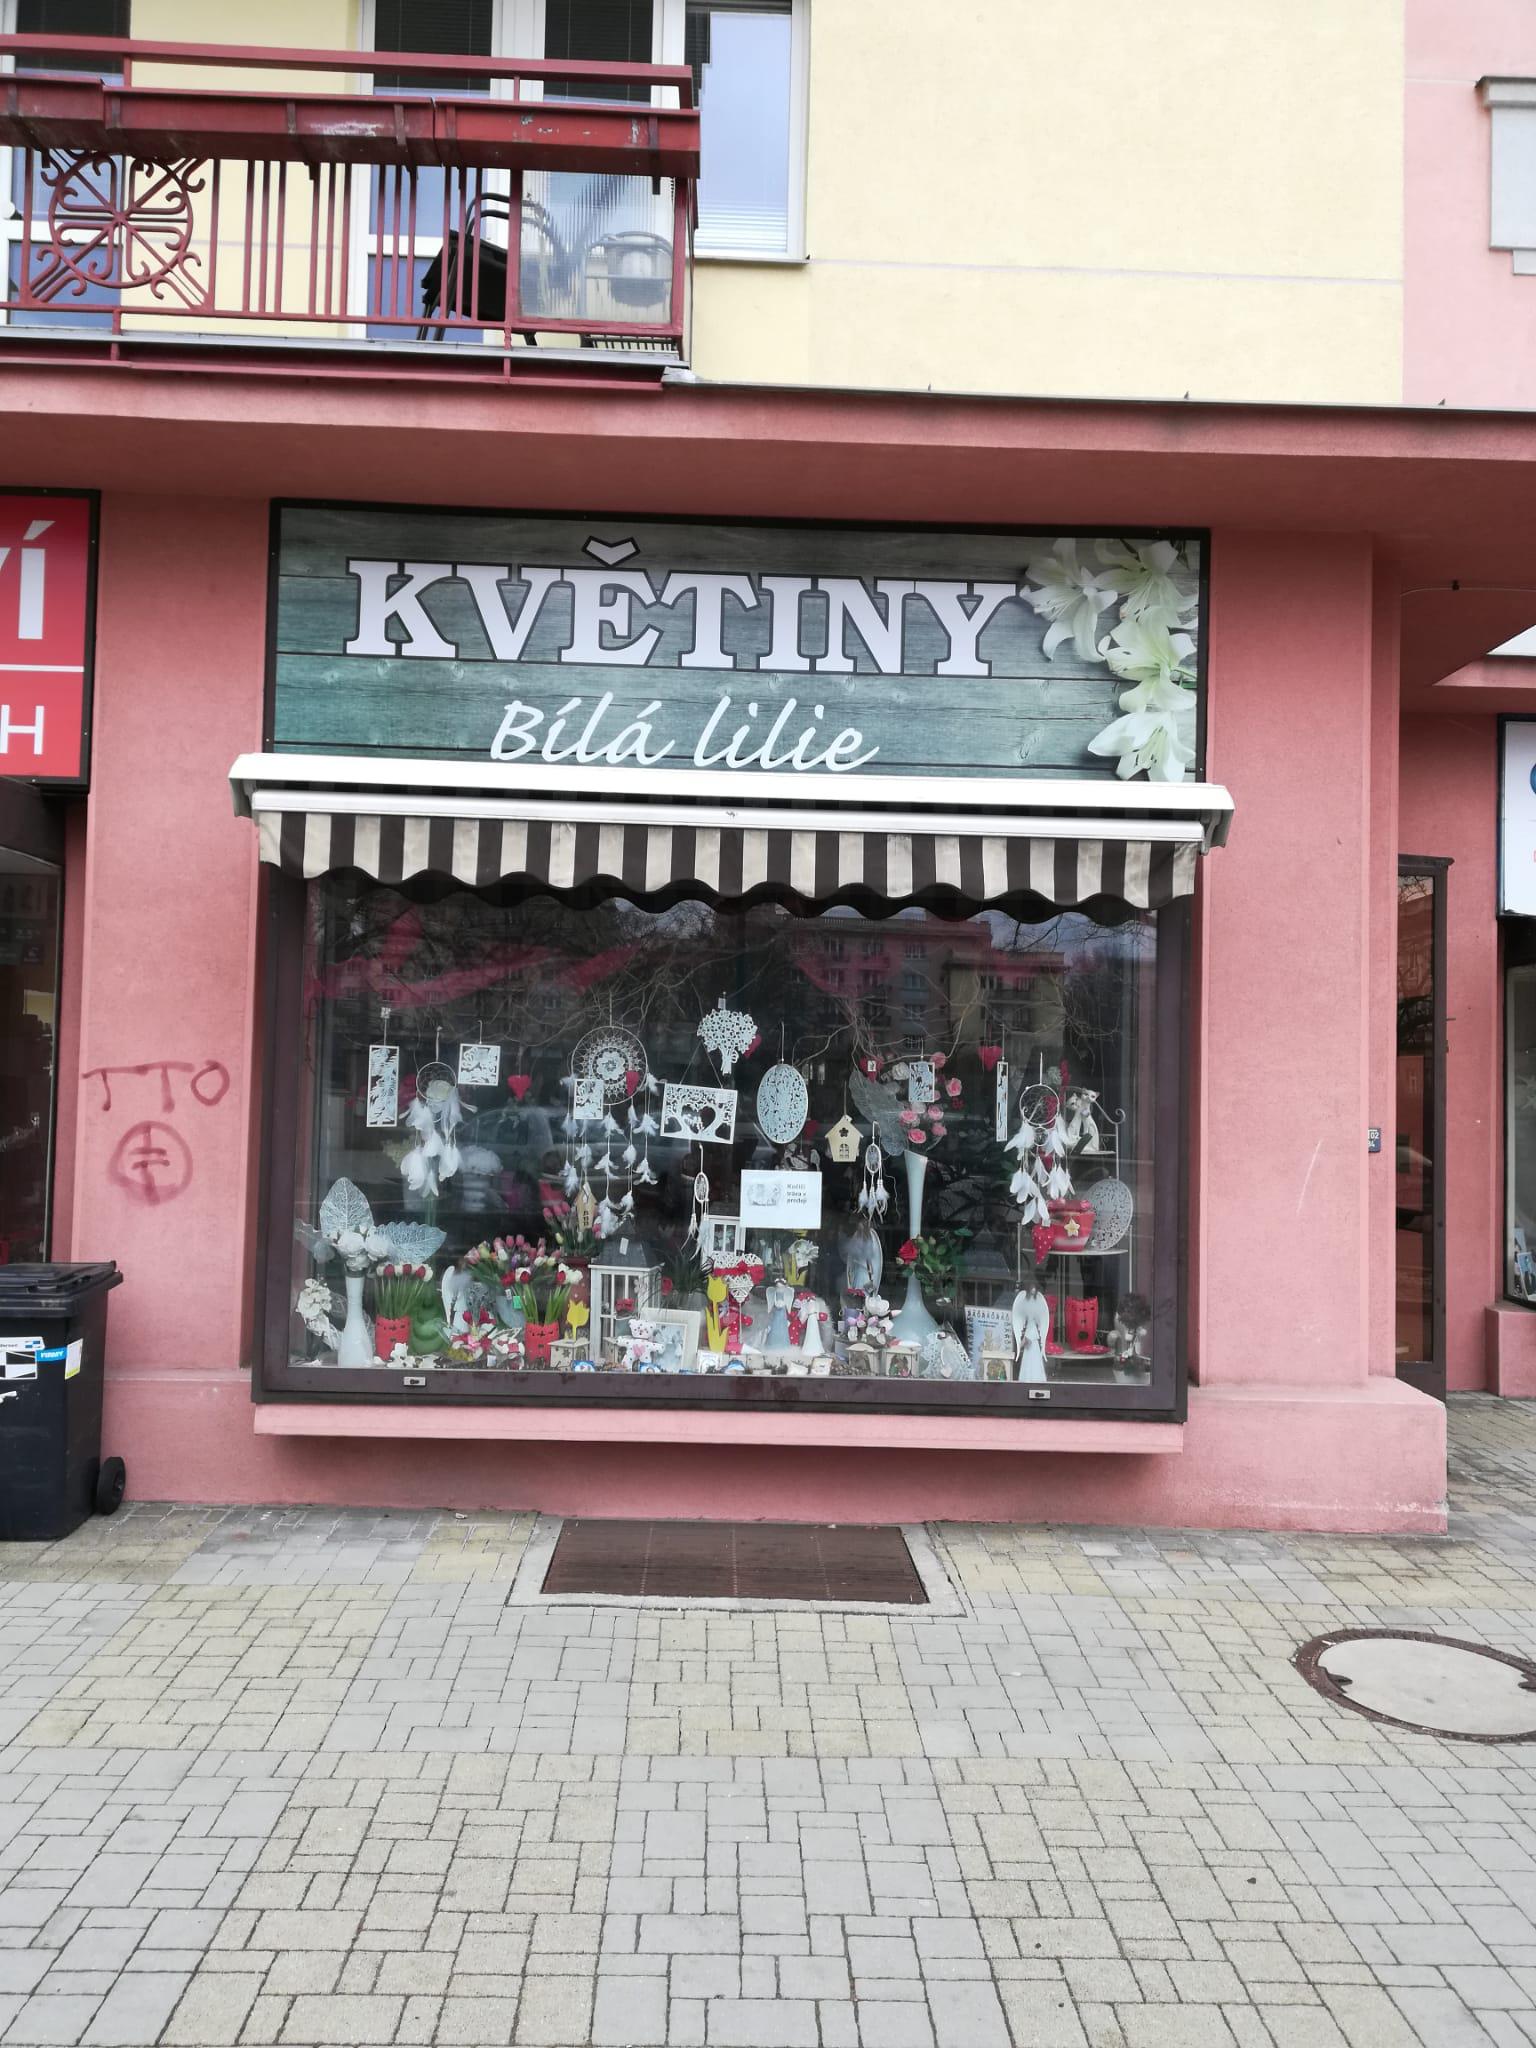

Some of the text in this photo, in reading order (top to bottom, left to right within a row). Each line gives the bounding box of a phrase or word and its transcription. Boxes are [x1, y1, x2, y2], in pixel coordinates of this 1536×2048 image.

[344, 536, 1020, 675] KVĚTINY
[489, 690, 881, 773] Bílá lilie
